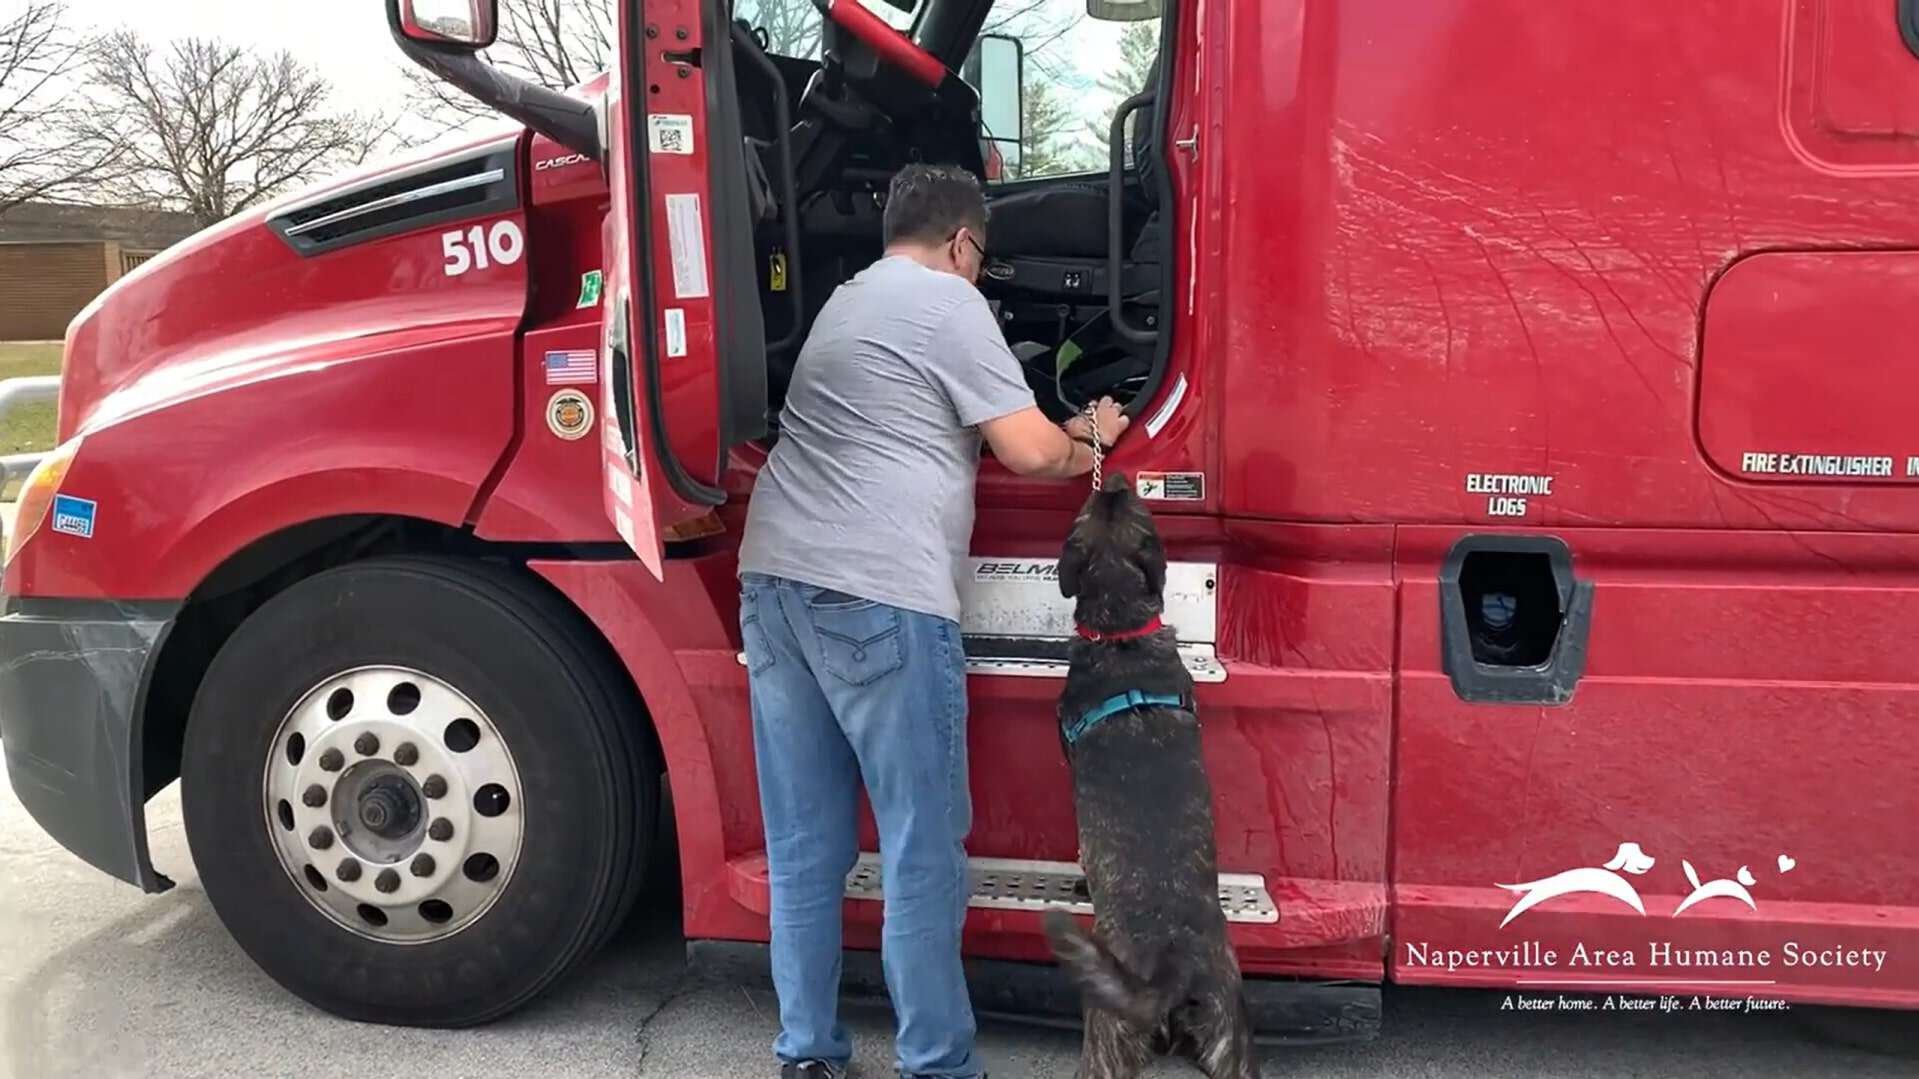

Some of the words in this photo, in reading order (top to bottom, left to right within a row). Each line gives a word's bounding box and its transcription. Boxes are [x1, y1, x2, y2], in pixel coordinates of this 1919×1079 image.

[442, 220, 524, 276] 510
[1742, 452, 1777, 473] FIRE
[1779, 454, 1893, 476] EXTINGUISHER
[1466, 473, 1553, 495] ELECTRONIC
[1488, 497, 1527, 516] LOGS
